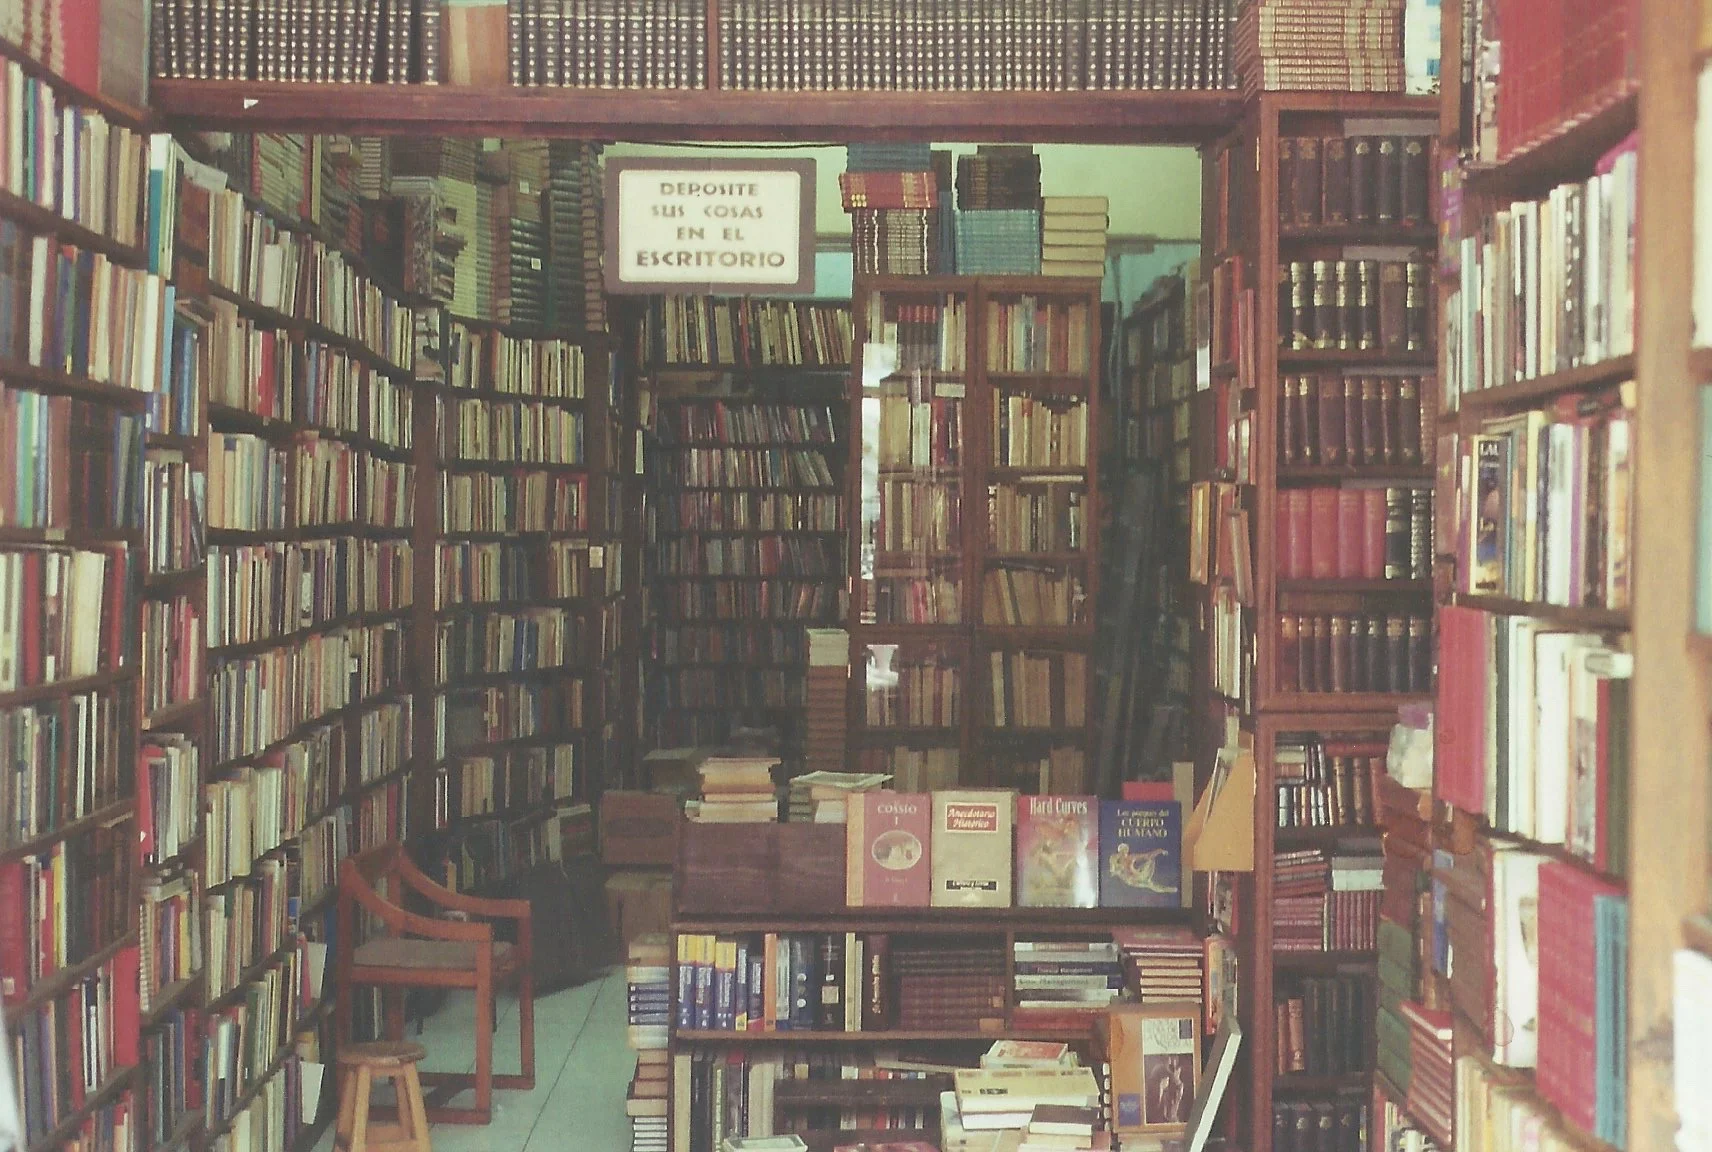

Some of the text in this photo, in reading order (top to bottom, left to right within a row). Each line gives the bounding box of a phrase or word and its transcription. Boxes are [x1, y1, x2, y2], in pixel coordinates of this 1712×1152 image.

[660, 182, 759, 196] DEPOSITE
[651, 204, 764, 219] SUS COSAS
[677, 227, 744, 241] EN EL
[636, 250, 785, 268] ESCRITORIO
[1030, 797, 1088, 815] Hard Curves
[1121, 818, 1164, 827] CUERPO
[1117, 828, 1168, 838] HUMANO
